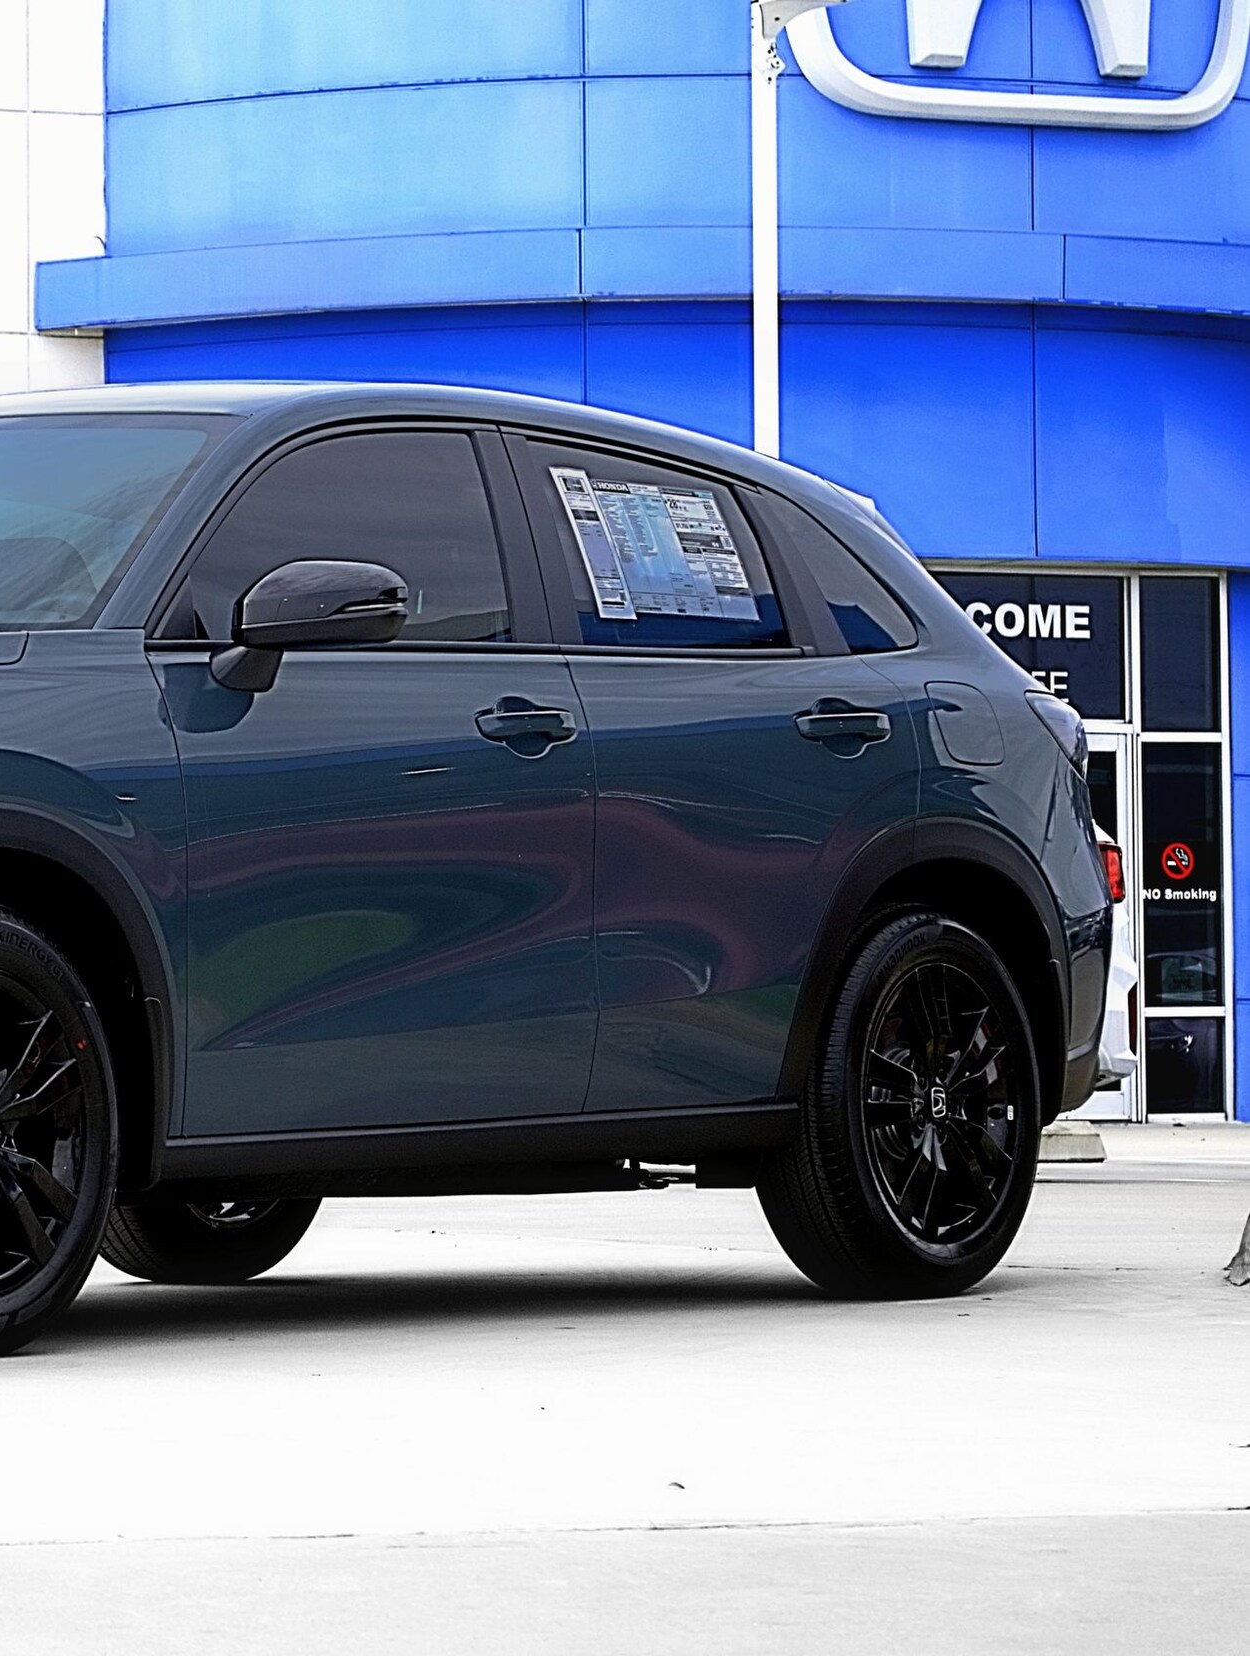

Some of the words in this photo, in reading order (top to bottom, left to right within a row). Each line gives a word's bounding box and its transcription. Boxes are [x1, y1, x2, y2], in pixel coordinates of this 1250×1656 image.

[597, 482, 629, 492] HONDA
[1142, 888, 1161, 900] NO
[1164, 888, 1217, 902] Smoking
